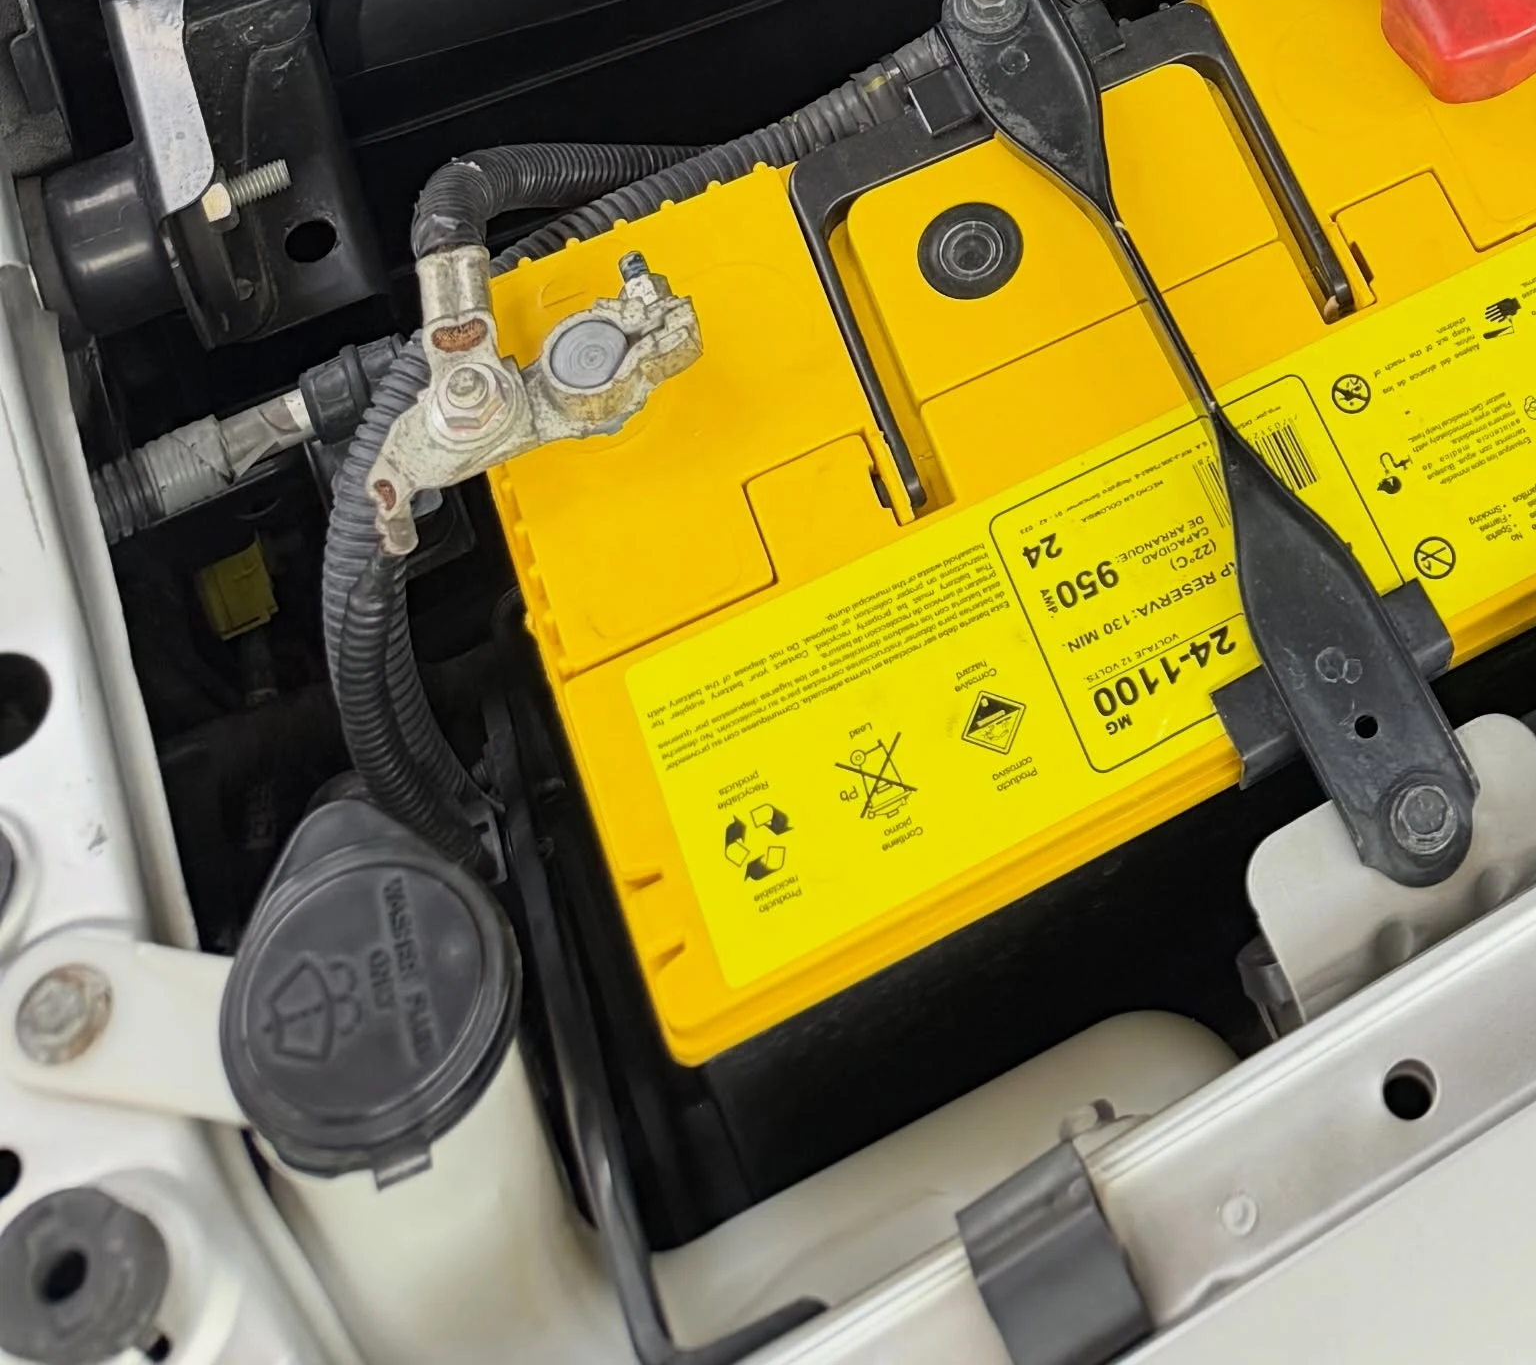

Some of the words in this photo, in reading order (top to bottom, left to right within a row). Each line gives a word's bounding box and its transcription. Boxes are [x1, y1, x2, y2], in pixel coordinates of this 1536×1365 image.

[1185, 513, 1205, 530] DE
[1467, 502, 1503, 526] Smoking
[1018, 530, 1065, 571] 24
[1113, 522, 1187, 565] ARRANQUE:
[1139, 524, 1211, 566] CAPACIDAD
[1508, 529, 1524, 543] No
[1051, 556, 1122, 612] 950
[1129, 569, 1218, 622] RESERVA:
[1100, 612, 1131, 637] 130
[1060, 627, 1100, 656] MIN.
[1132, 630, 1180, 660] VOLTAJE
[953, 657, 988, 681] hazard
[1082, 660, 1121, 686] VOLTS.
[1089, 623, 1240, 720] 24-1100
[1119, 654, 1133, 667] 12
[952, 665, 998, 695] Corrosive
[846, 720, 873, 740] Lead
[1103, 711, 1134, 737] MG
[989, 754, 1034, 782] corrosivo
[994, 764, 1038, 794] Producto
[715, 778, 770, 812] Recyclable
[716, 769, 760, 797] products
[837, 783, 860, 806] Pb
[879, 823, 924, 854] Contiene
[881, 815, 913, 838] plomo
[751, 872, 799, 904] reciclable
[756, 884, 803, 916] Producto
